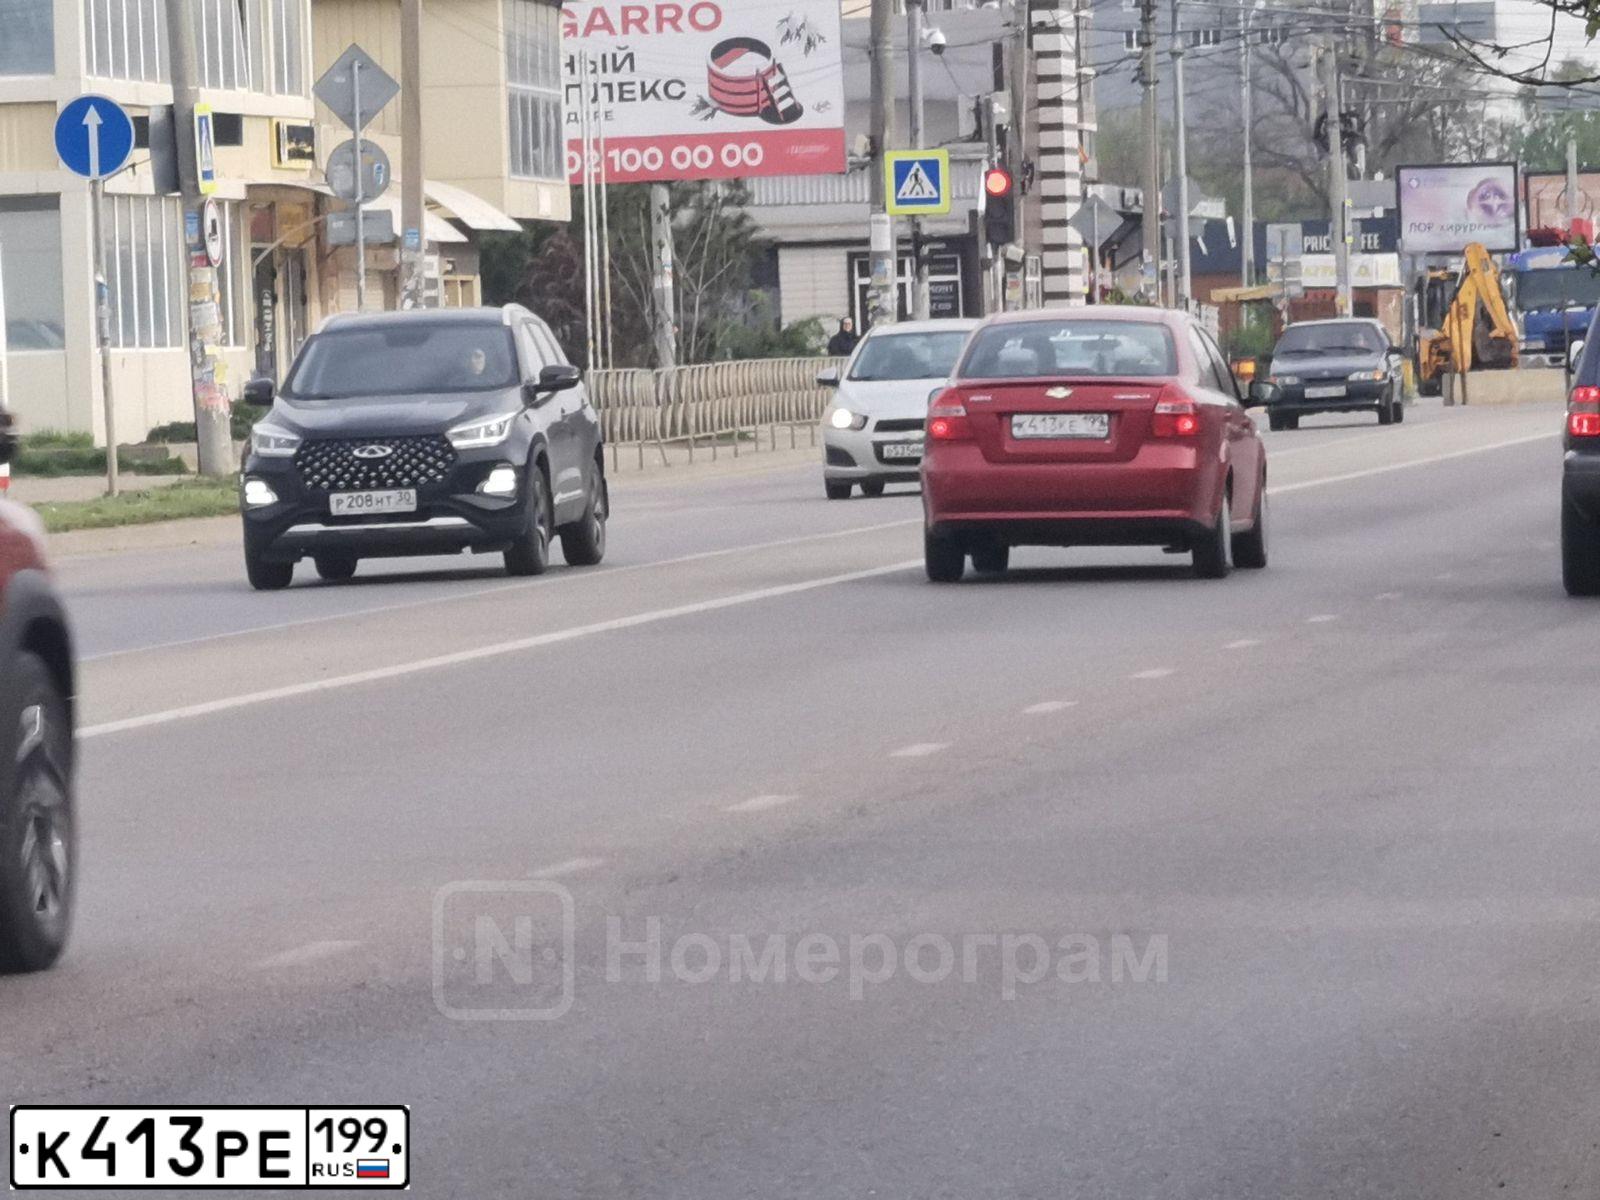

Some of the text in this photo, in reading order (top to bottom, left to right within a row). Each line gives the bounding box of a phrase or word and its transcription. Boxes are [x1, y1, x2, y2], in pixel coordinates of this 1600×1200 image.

[608, 148, 664, 173] 100
[671, 145, 713, 170] 00
[721, 143, 763, 168] 00
[1303, 235, 1331, 252] PRIC
